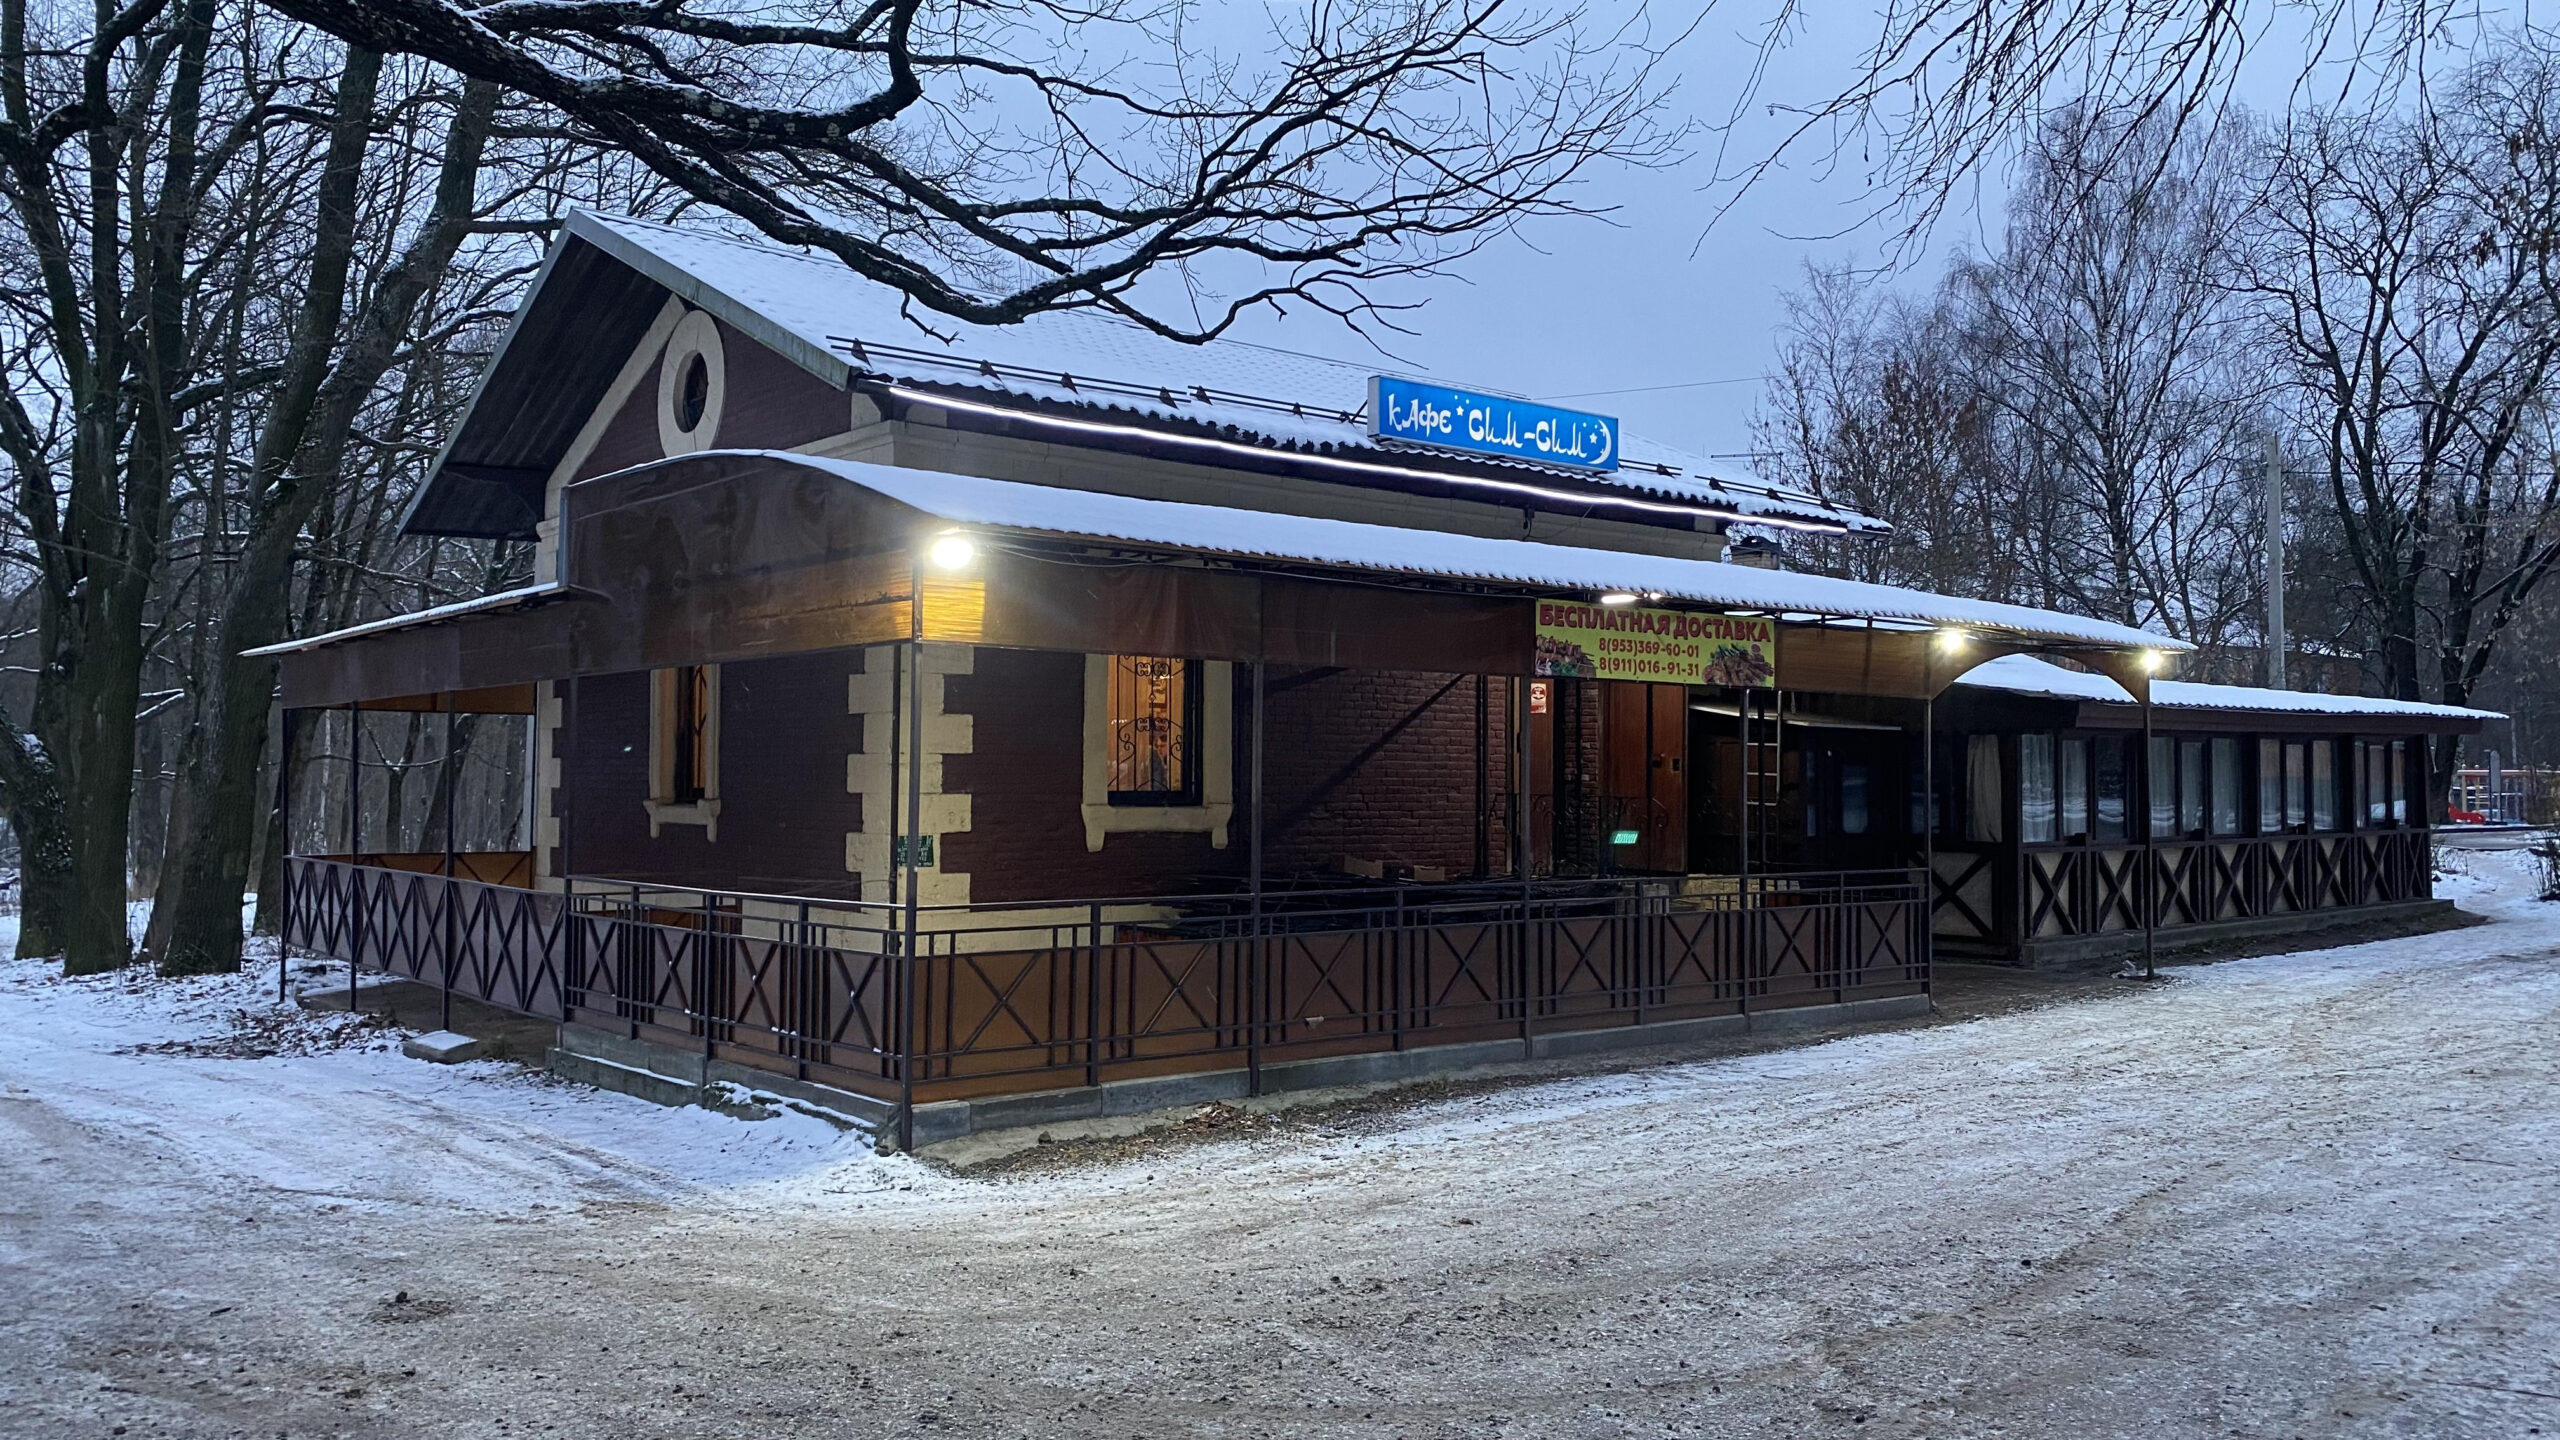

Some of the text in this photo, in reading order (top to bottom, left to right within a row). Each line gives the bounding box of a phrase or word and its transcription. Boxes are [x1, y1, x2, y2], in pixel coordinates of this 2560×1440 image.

[1539, 604, 1772, 642] БЕСПЛАТНАЯ ДОСТАВКА
[1598, 638, 1700, 658] 8(953)369-60-01
[1598, 659, 1700, 677] 8(911)016-91-31
